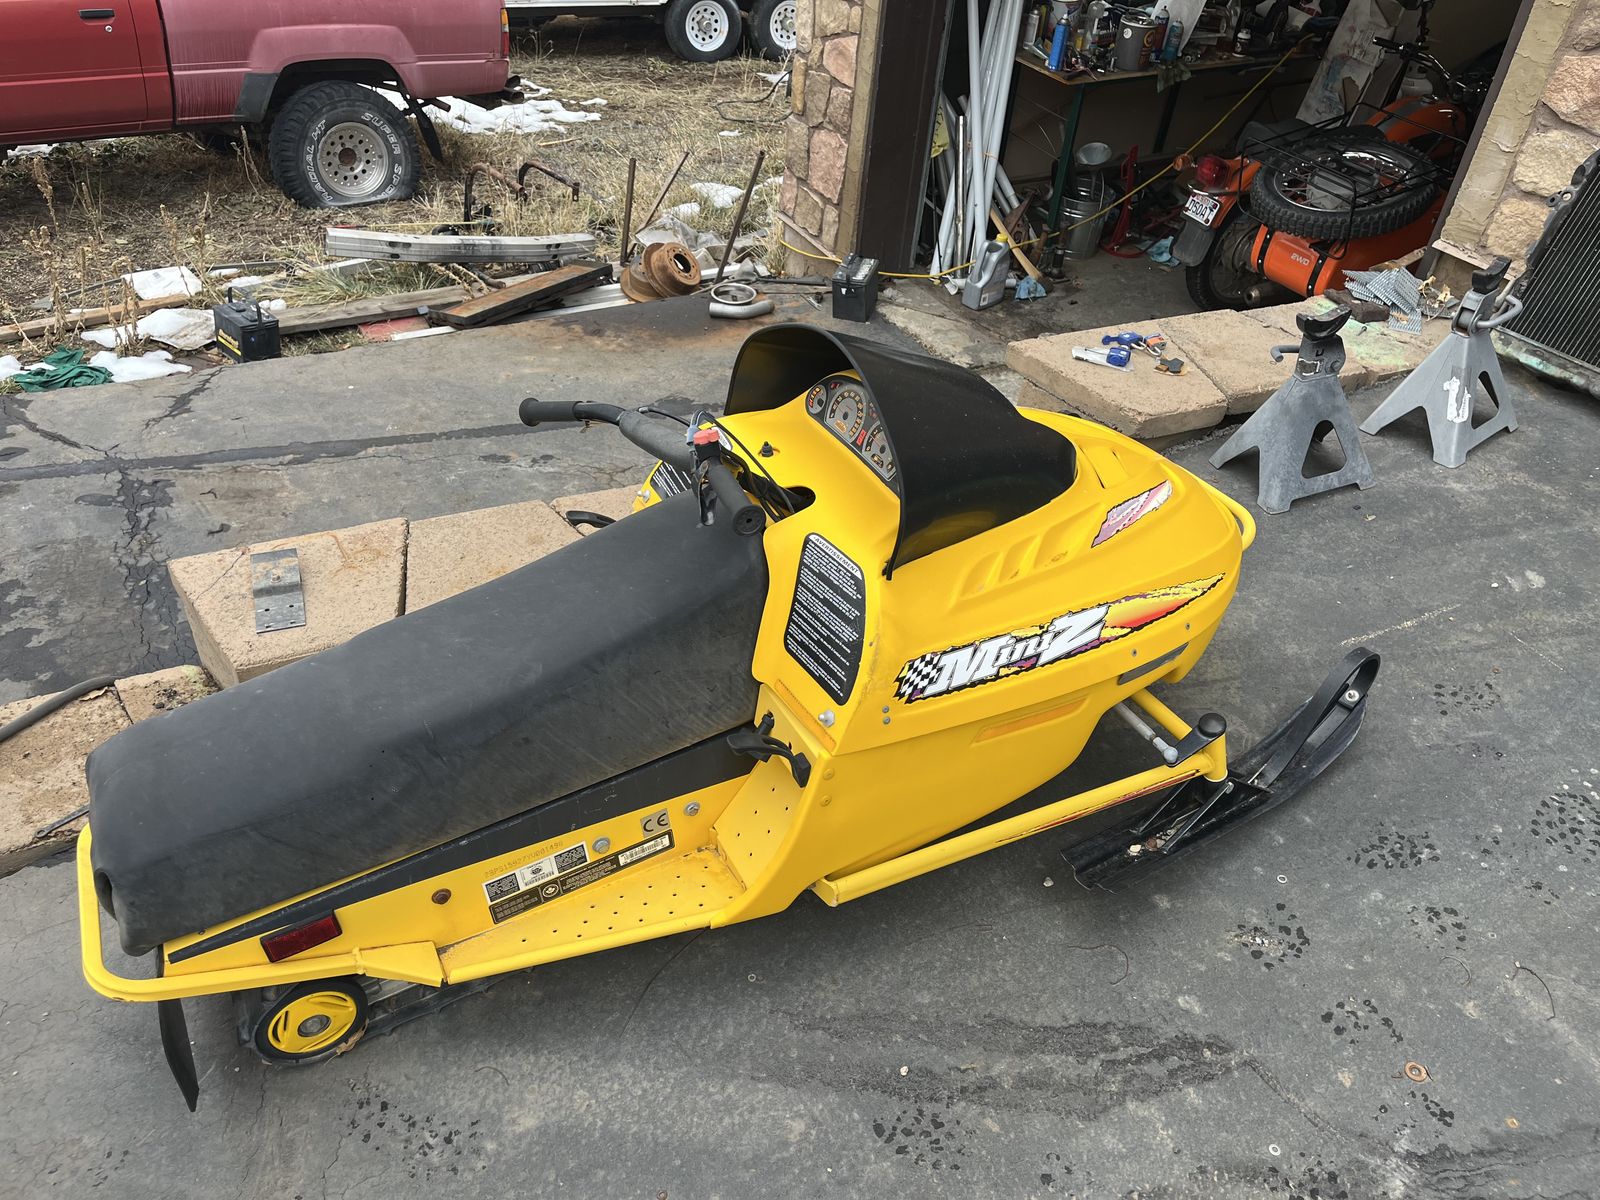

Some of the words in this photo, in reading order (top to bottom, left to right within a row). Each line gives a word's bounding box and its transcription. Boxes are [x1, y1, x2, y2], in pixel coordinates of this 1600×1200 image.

[361, 112, 401, 155] SUPER
[305, 145, 334, 202] RADIAL
[814, 537, 860, 574] AVERTISSEMENT
[643, 812, 669, 832] CE
